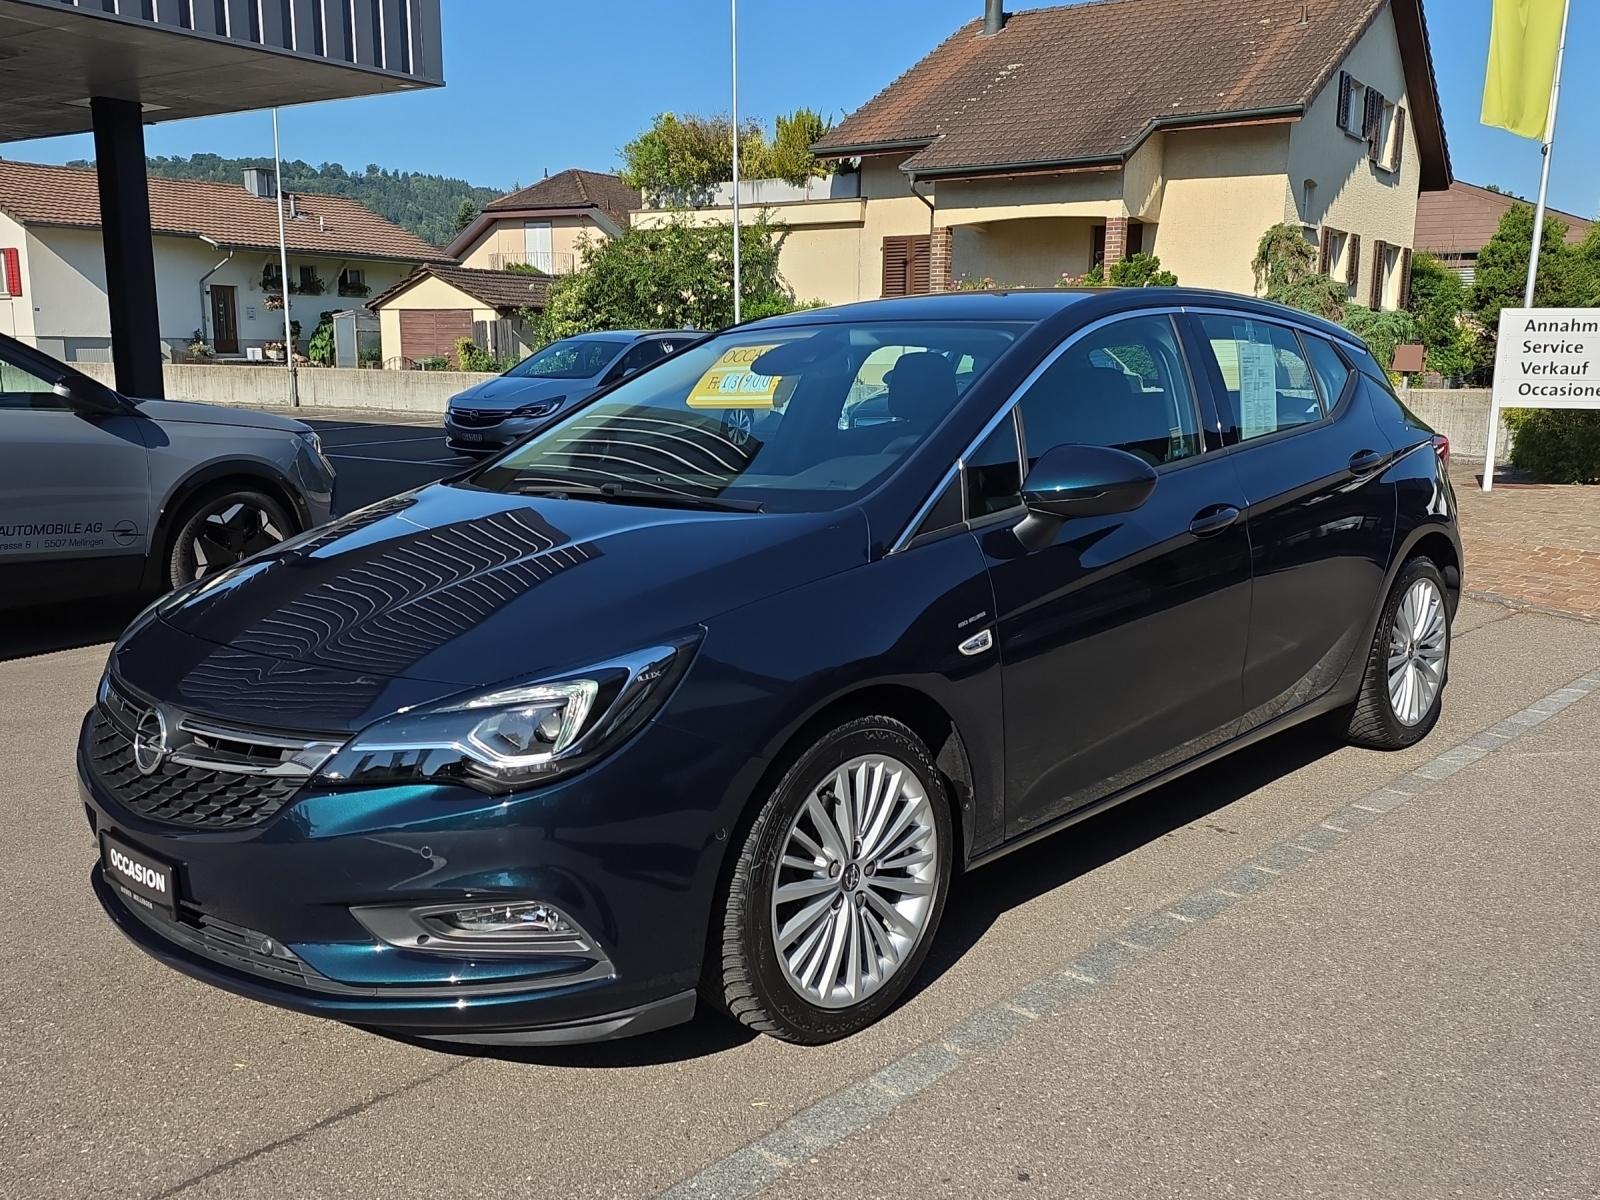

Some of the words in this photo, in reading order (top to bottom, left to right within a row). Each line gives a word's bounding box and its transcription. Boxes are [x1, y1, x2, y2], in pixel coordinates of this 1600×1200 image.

[1524, 318, 1600, 332] Annahm
[1522, 340, 1584, 354] Service
[1521, 361, 1590, 375] Verkauf
[0, 523, 82, 537] AUTOMOBILE
[84, 522, 103, 534] AG
[0, 541, 23, 550] rasse
[110, 848, 166, 893] OCCASION
